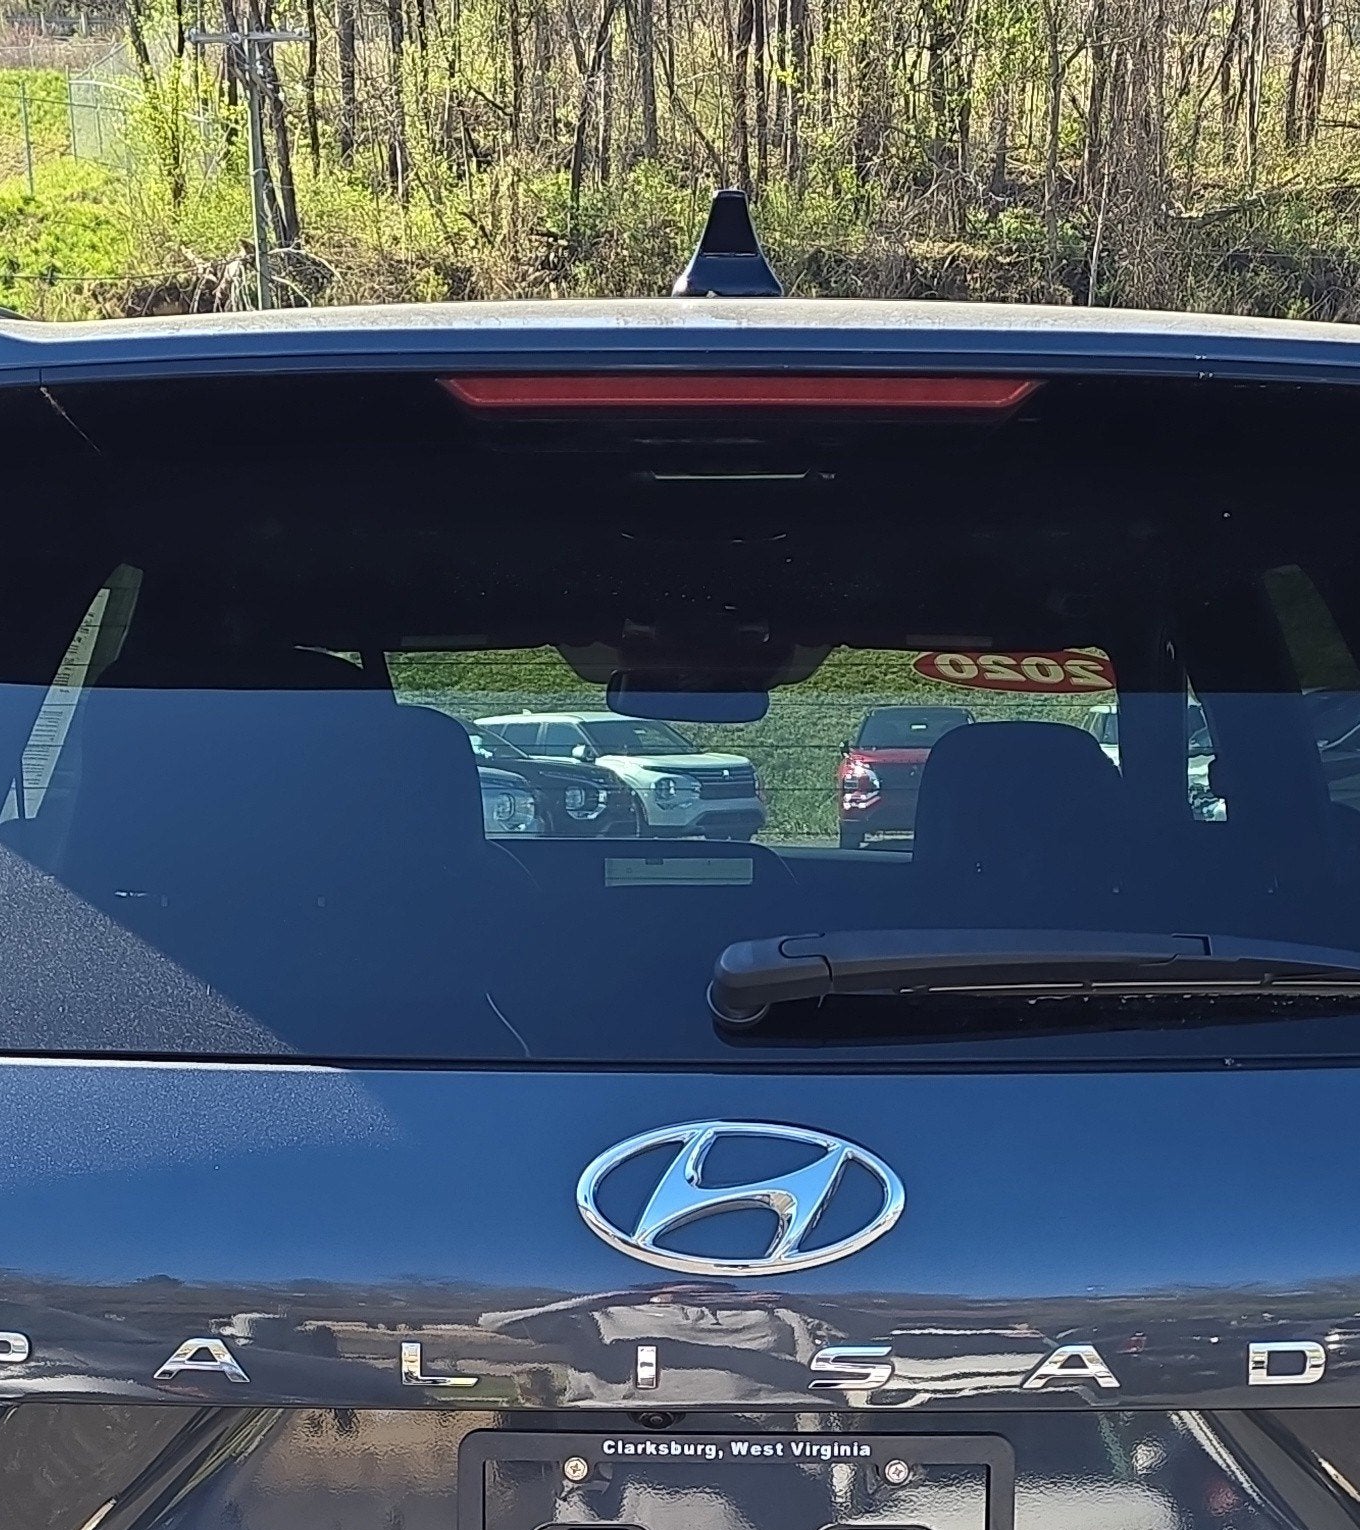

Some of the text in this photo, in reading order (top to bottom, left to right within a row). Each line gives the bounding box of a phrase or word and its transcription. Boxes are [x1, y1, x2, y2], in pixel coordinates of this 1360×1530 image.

[602, 1439, 871, 1460] Clarksburg, West Virginia
